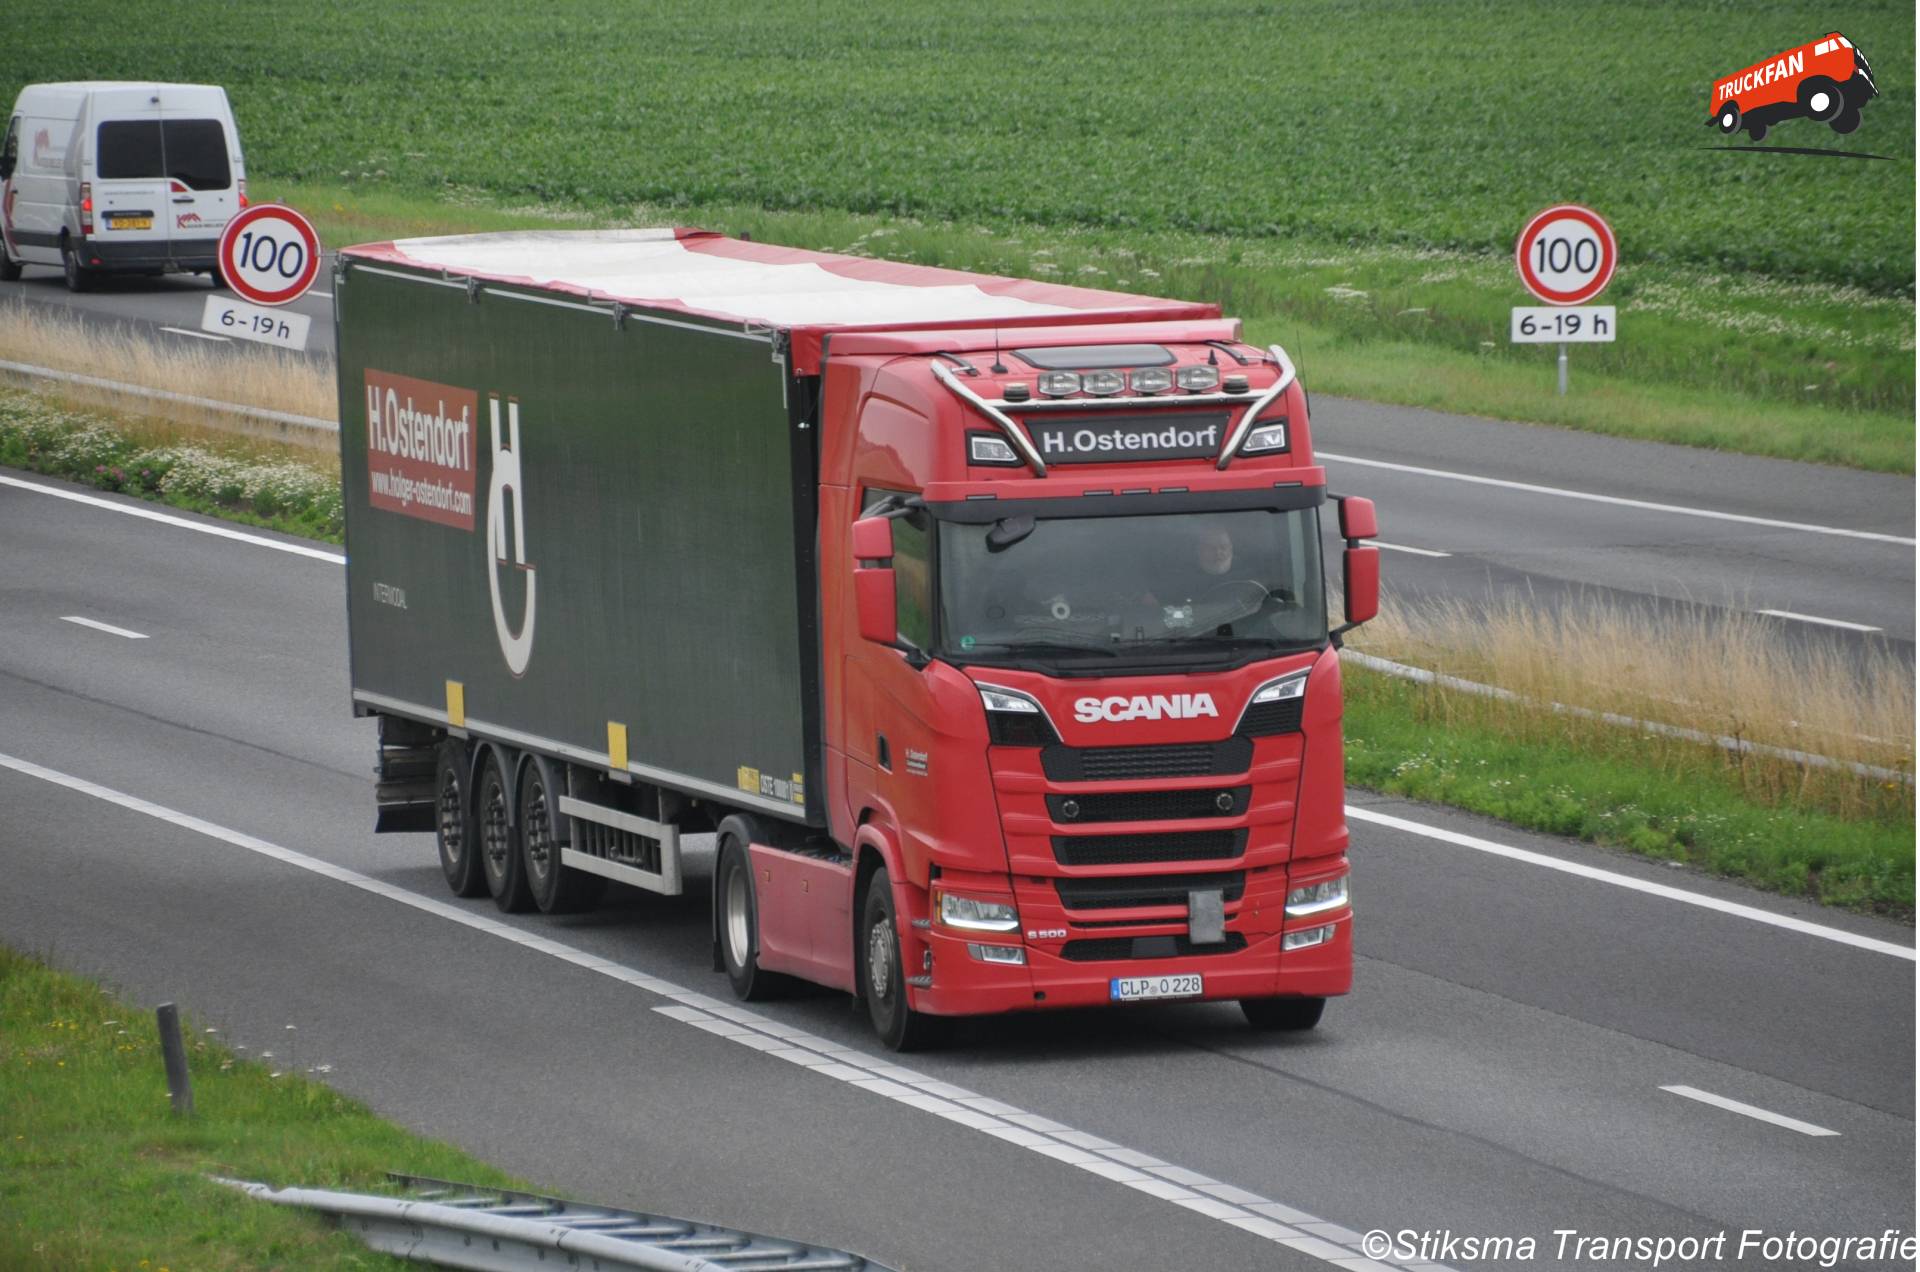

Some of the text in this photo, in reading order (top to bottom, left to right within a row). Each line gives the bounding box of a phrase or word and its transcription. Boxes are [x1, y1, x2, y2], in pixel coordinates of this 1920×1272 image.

[240, 231, 303, 279] 100
[1536, 237, 1598, 274] 100
[1520, 314, 1608, 336] 6-19 h
[367, 384, 470, 471] H.Ostendorf
[1043, 425, 1217, 453] H.Ostendorf
[371, 470, 473, 516] www.holger-ostendorf.com
[1074, 693, 1218, 723] SCANIA
[1027, 929, 1067, 939] S 500
[1120, 980, 1150, 996] CLP
[1173, 977, 1200, 992] 228
